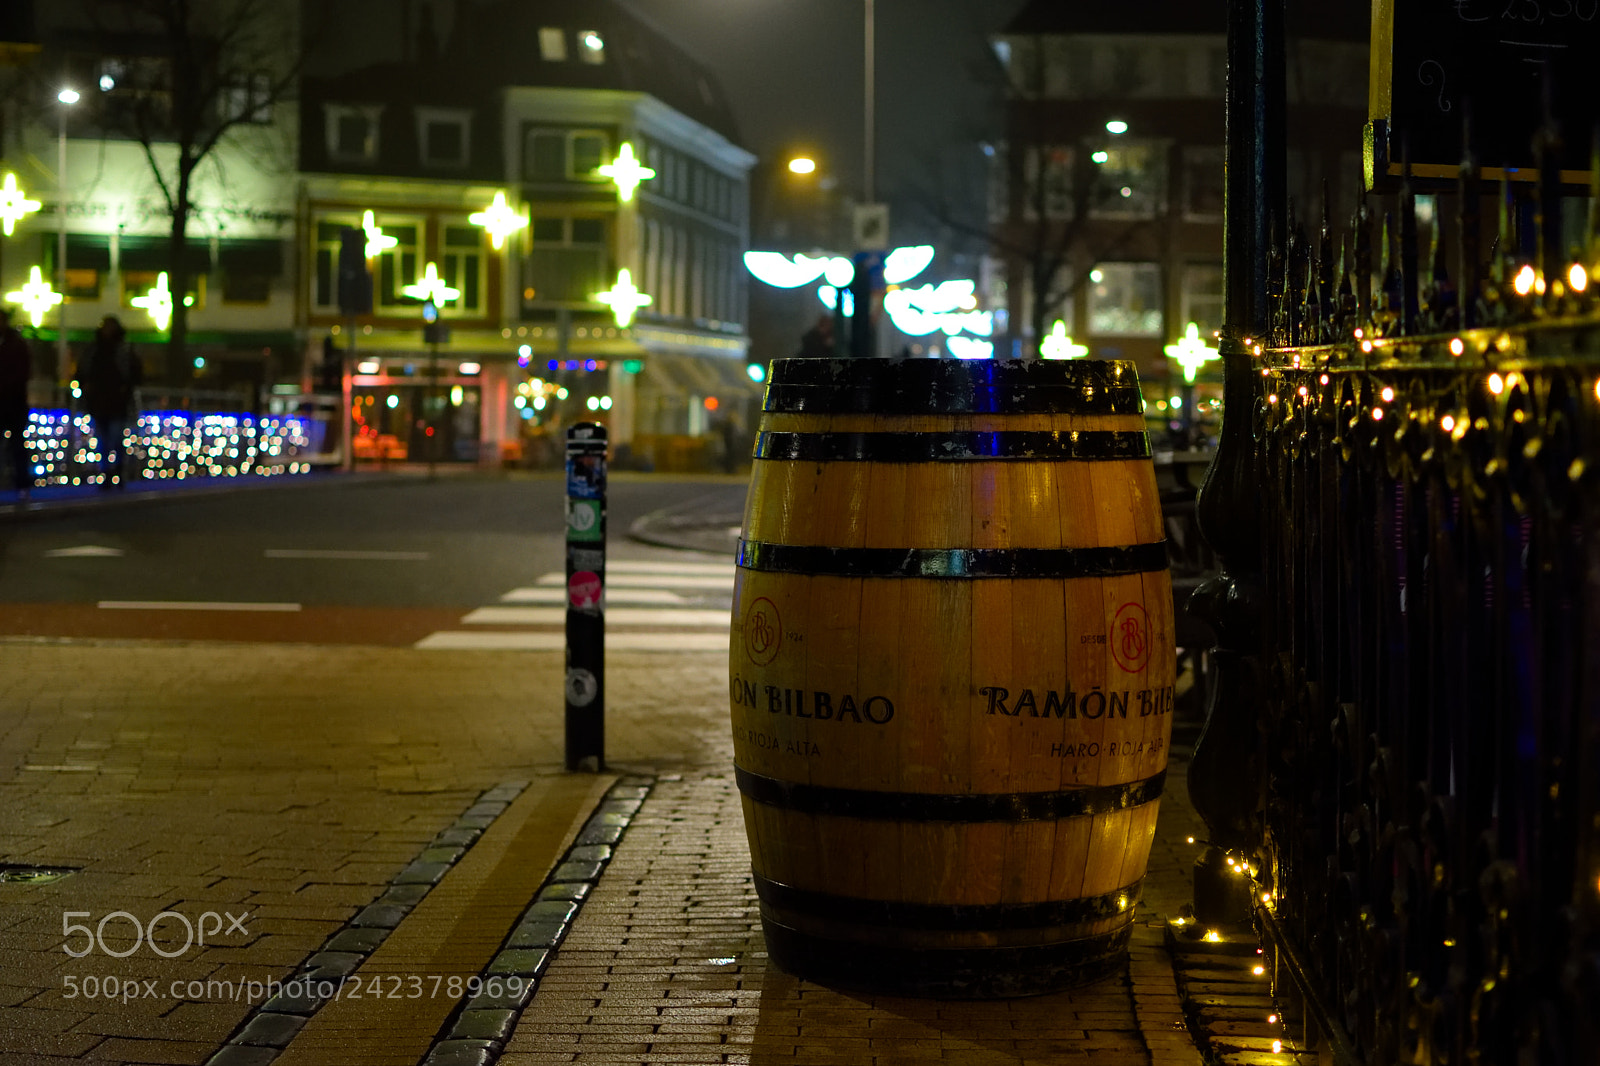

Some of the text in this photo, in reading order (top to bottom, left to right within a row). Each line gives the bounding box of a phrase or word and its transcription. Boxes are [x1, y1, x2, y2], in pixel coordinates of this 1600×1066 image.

[1080, 634, 1107, 645] DESDE
[765, 685, 895, 725] BILBAO
[979, 685, 1175, 720] RAMÓN BILB
[748, 730, 780, 751] RIOJA
[787, 742, 821, 758] ALTA
[1050, 742, 1101, 758] HARO
[1109, 740, 1144, 757] RIOJA
